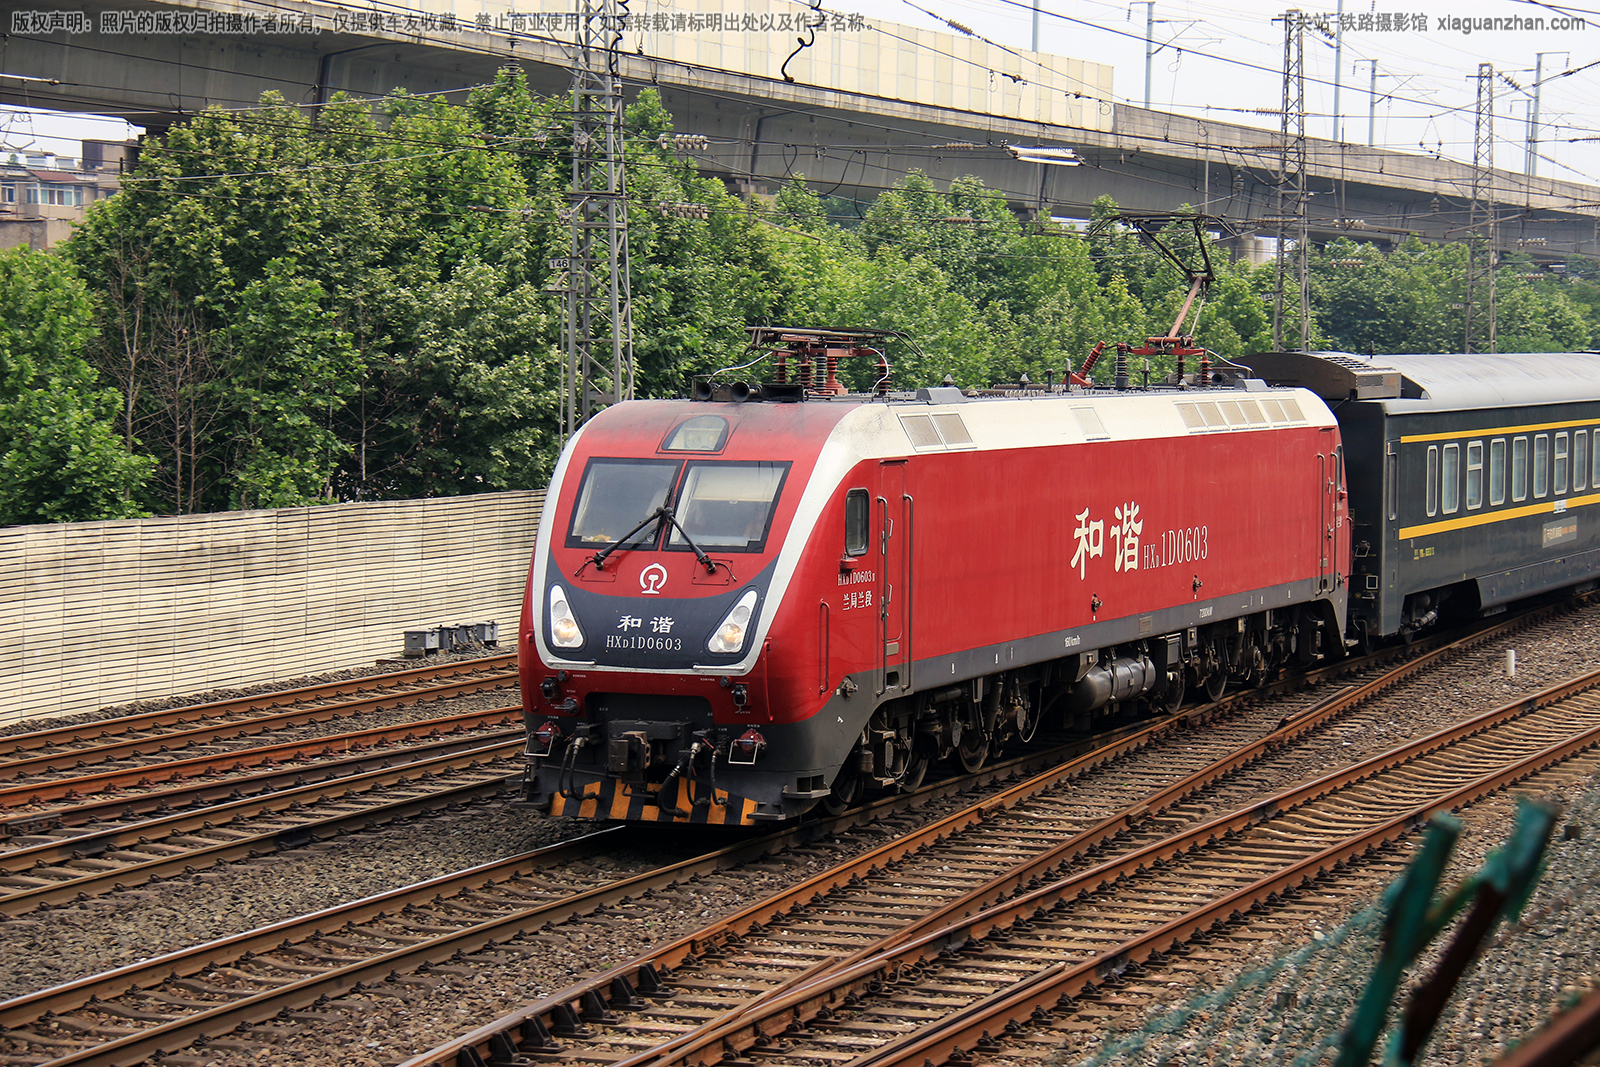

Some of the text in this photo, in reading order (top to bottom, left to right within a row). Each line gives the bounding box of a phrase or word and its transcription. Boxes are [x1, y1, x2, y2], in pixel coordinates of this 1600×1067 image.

[551, 259, 568, 268] 146
[1070, 500, 1144, 581] 和谐
[842, 590, 872, 611] 兰局兰段
[616, 614, 675, 634] 和谐
[605, 635, 682, 650] HXD1D0603
